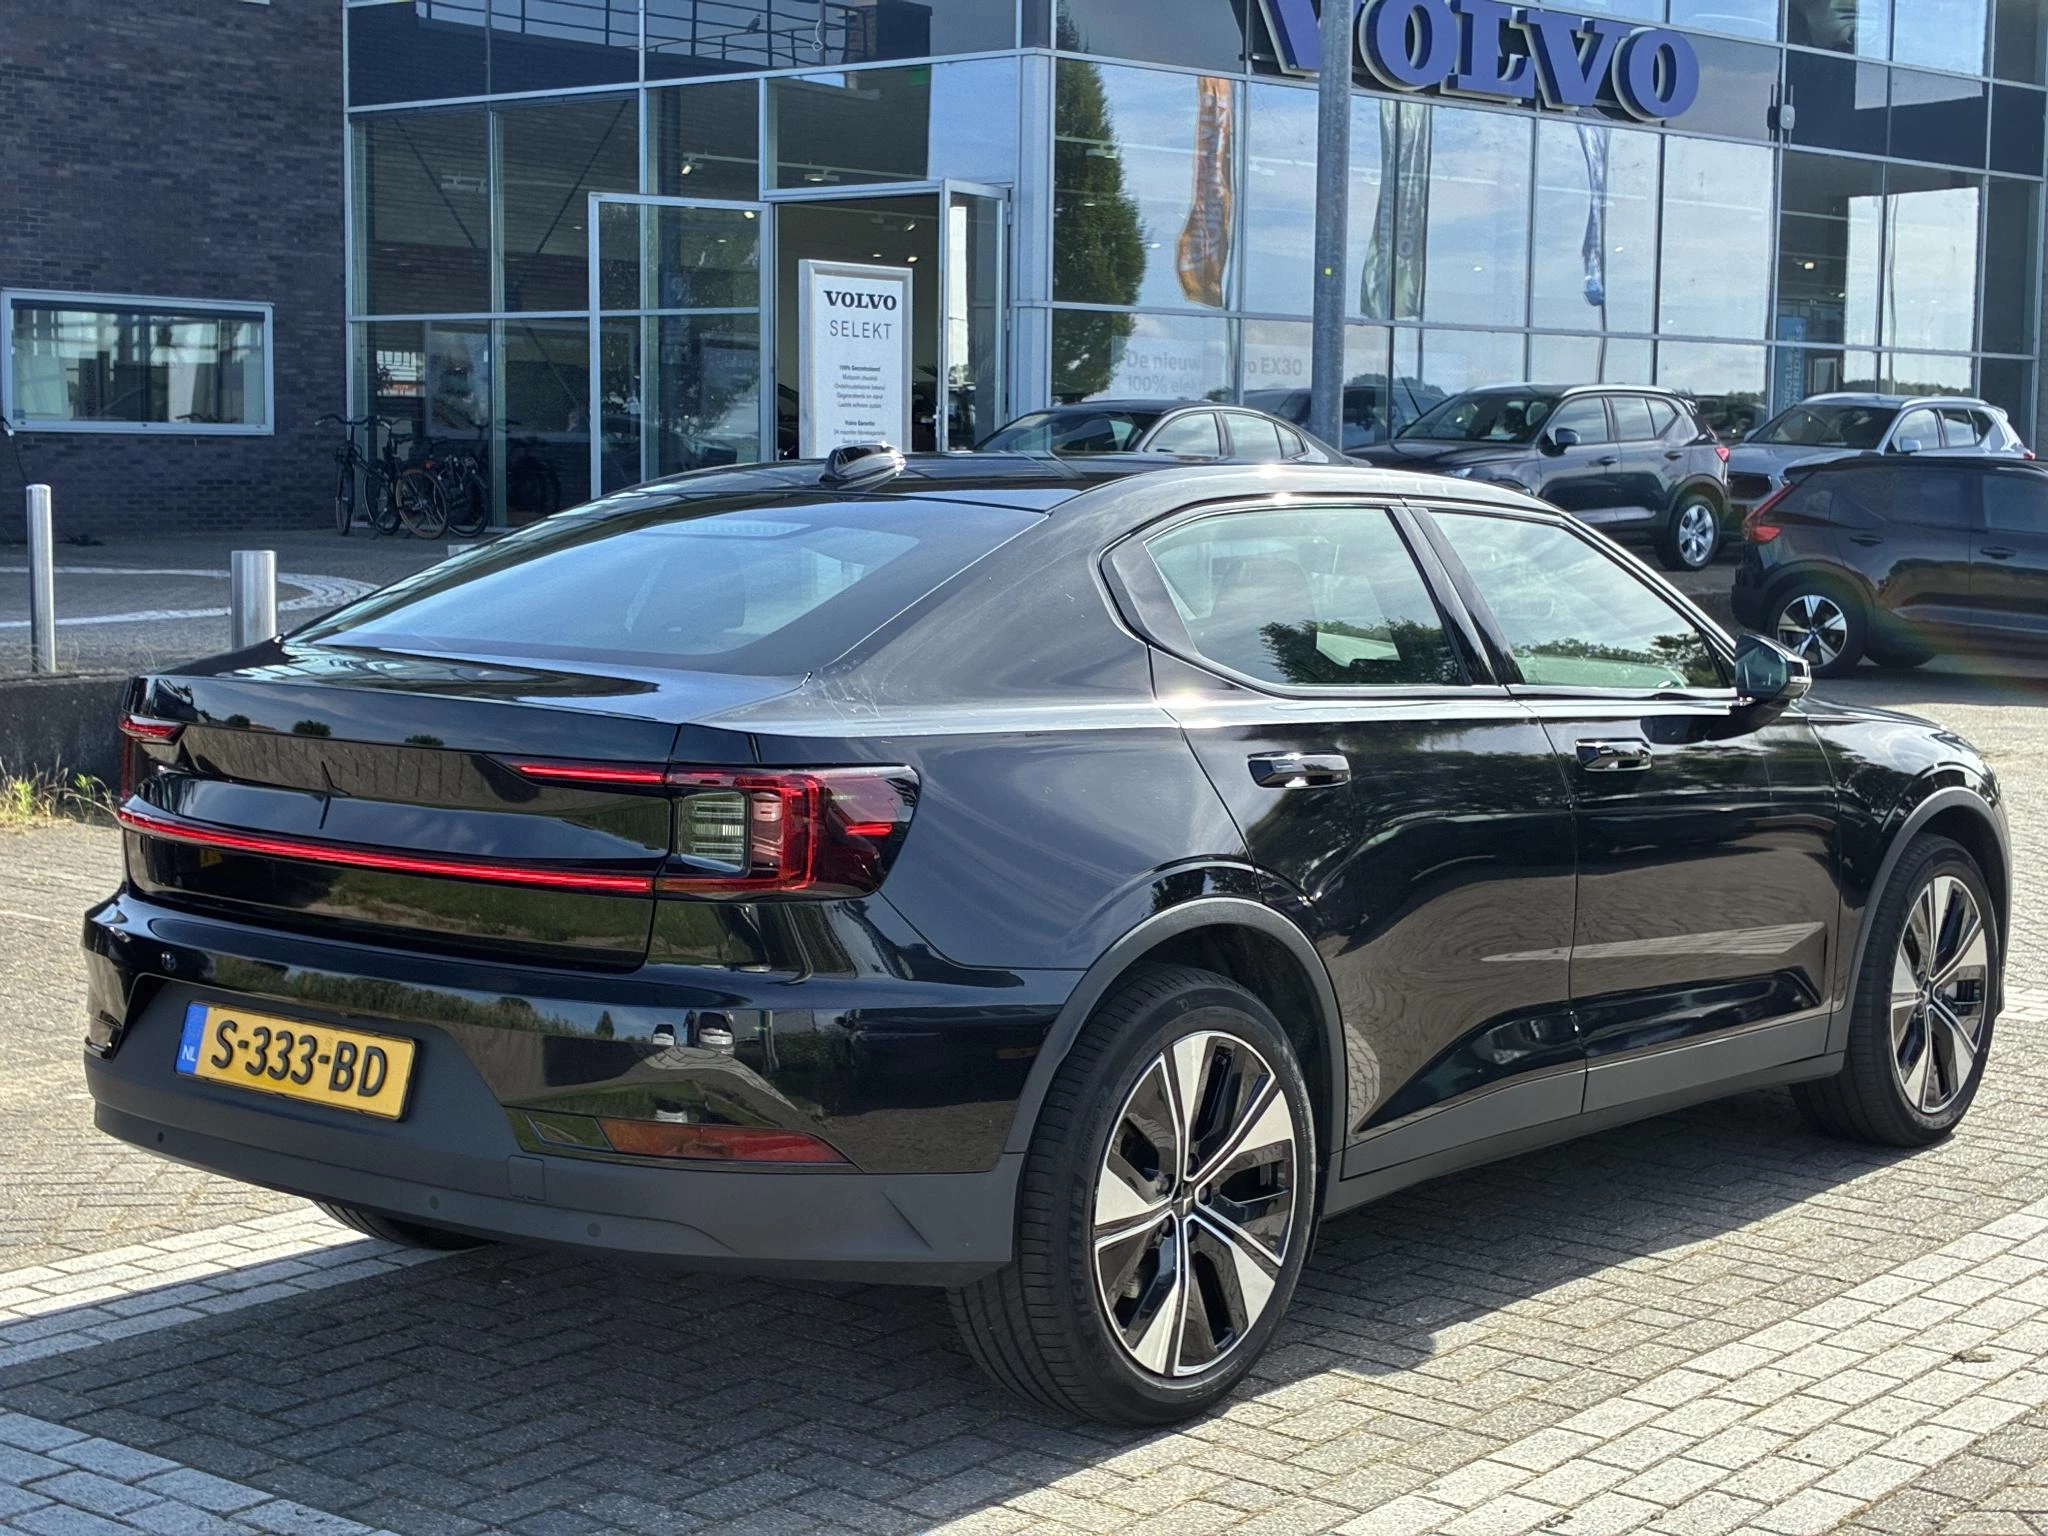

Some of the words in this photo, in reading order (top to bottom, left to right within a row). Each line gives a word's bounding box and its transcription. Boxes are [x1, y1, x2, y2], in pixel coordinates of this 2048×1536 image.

[823, 290, 897, 311] VOLVO
[830, 319, 892, 339] SELEKT
[1153, 352, 1200, 371] nieuw
[1261, 356, 1303, 377] EX30
[1127, 375, 1168, 394] 100%
[181, 1045, 196, 1062] NL
[211, 1020, 388, 1097] S-333-BD
